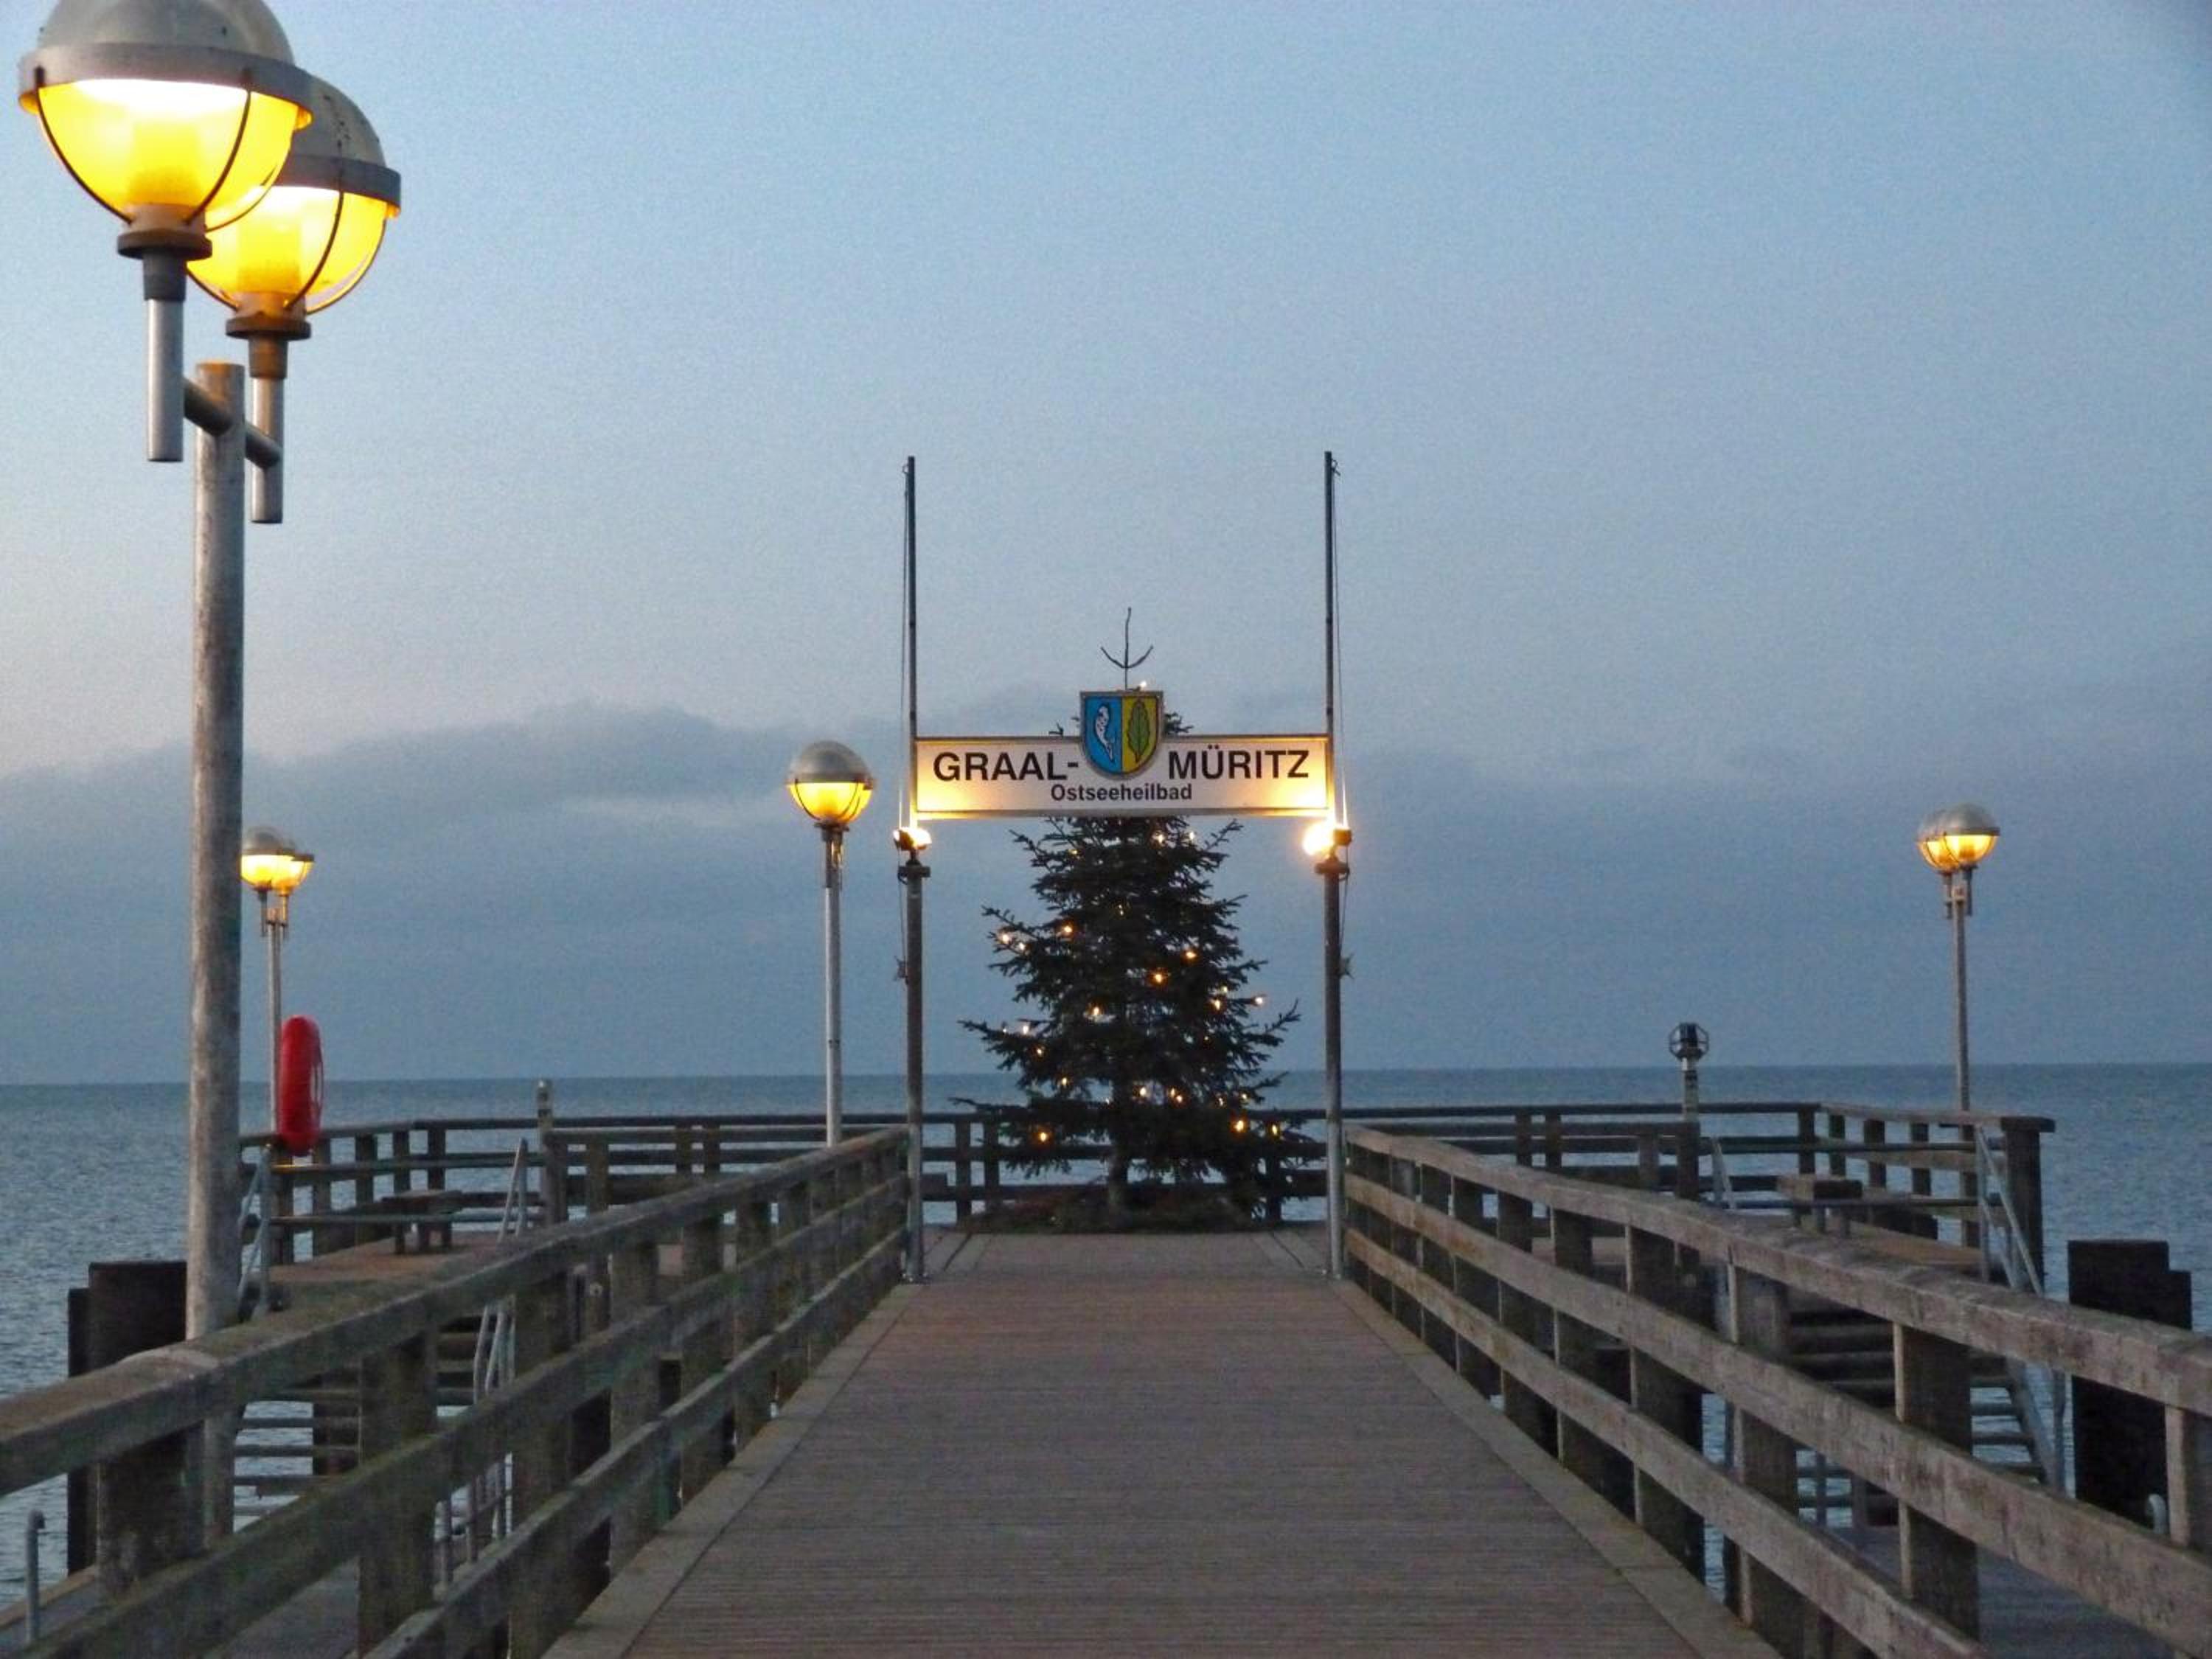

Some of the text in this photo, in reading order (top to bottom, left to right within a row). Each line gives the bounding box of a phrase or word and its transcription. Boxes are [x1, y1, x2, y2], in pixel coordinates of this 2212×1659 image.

[933, 744, 1310, 782] GRAAL- MÜRITZ
[1051, 782, 1193, 801] Ostseeheilbad
